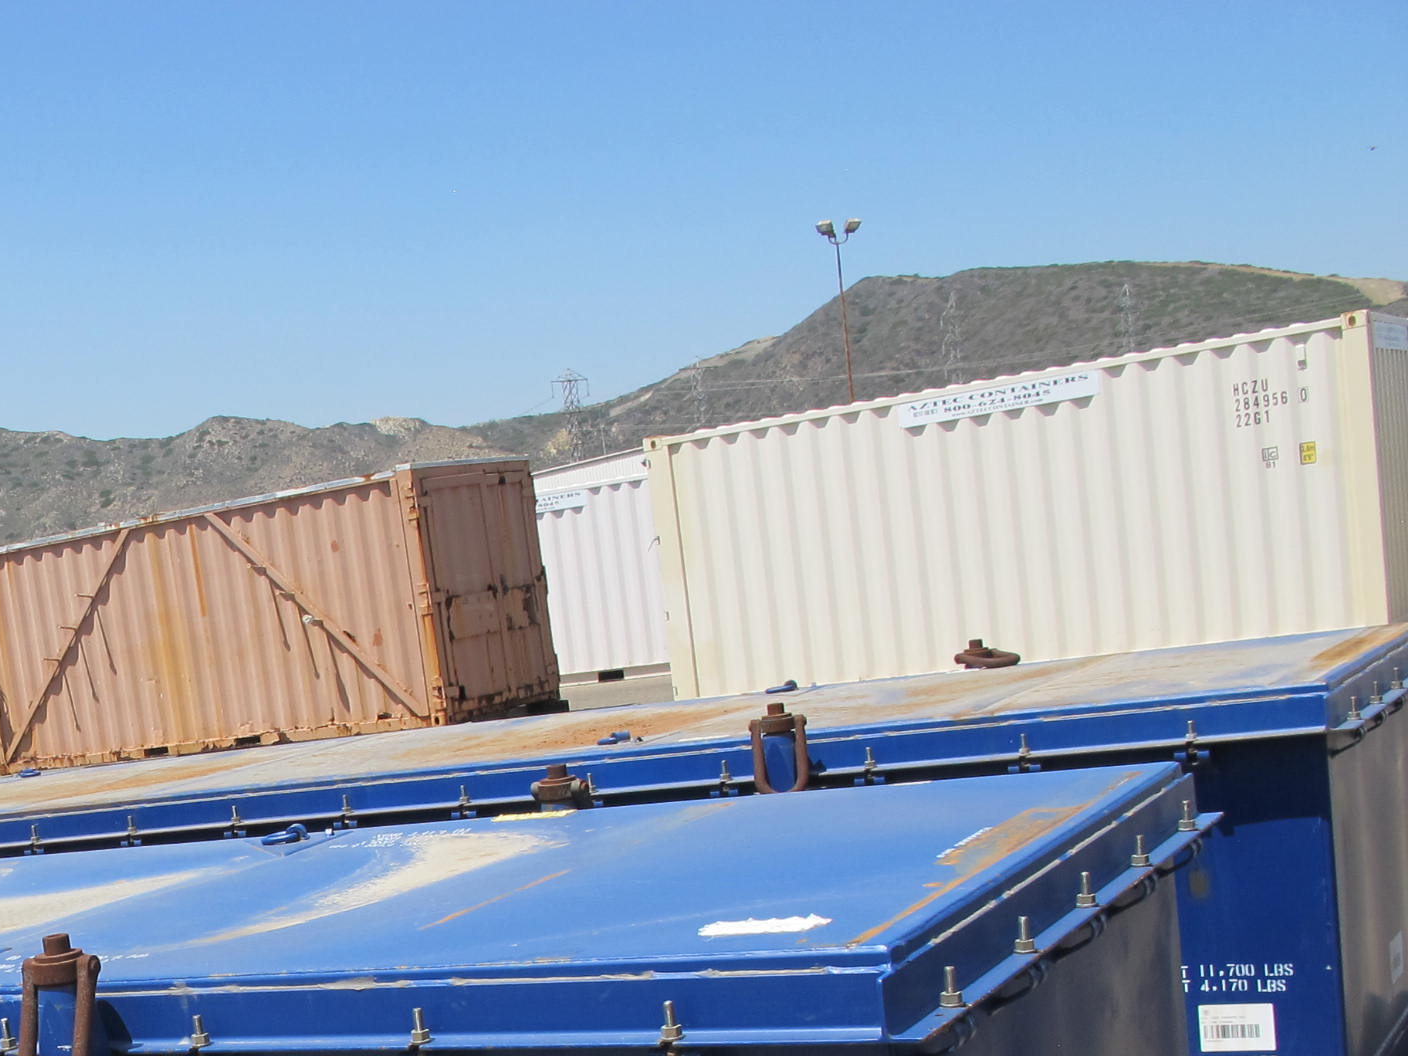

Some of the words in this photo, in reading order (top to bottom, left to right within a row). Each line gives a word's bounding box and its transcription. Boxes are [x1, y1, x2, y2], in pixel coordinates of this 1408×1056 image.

[908, 396, 961, 412] AZTEC
[968, 373, 1089, 401] CONTAINERS
[1233, 378, 1269, 396] HCZU
[943, 388, 1051, 415] 800-624-8045
[1235, 391, 1288, 412] 284956
[1236, 410, 1270, 428] 22G1
[1264, 963, 1294, 977] LBS
[1257, 979, 1287, 992] LBS
